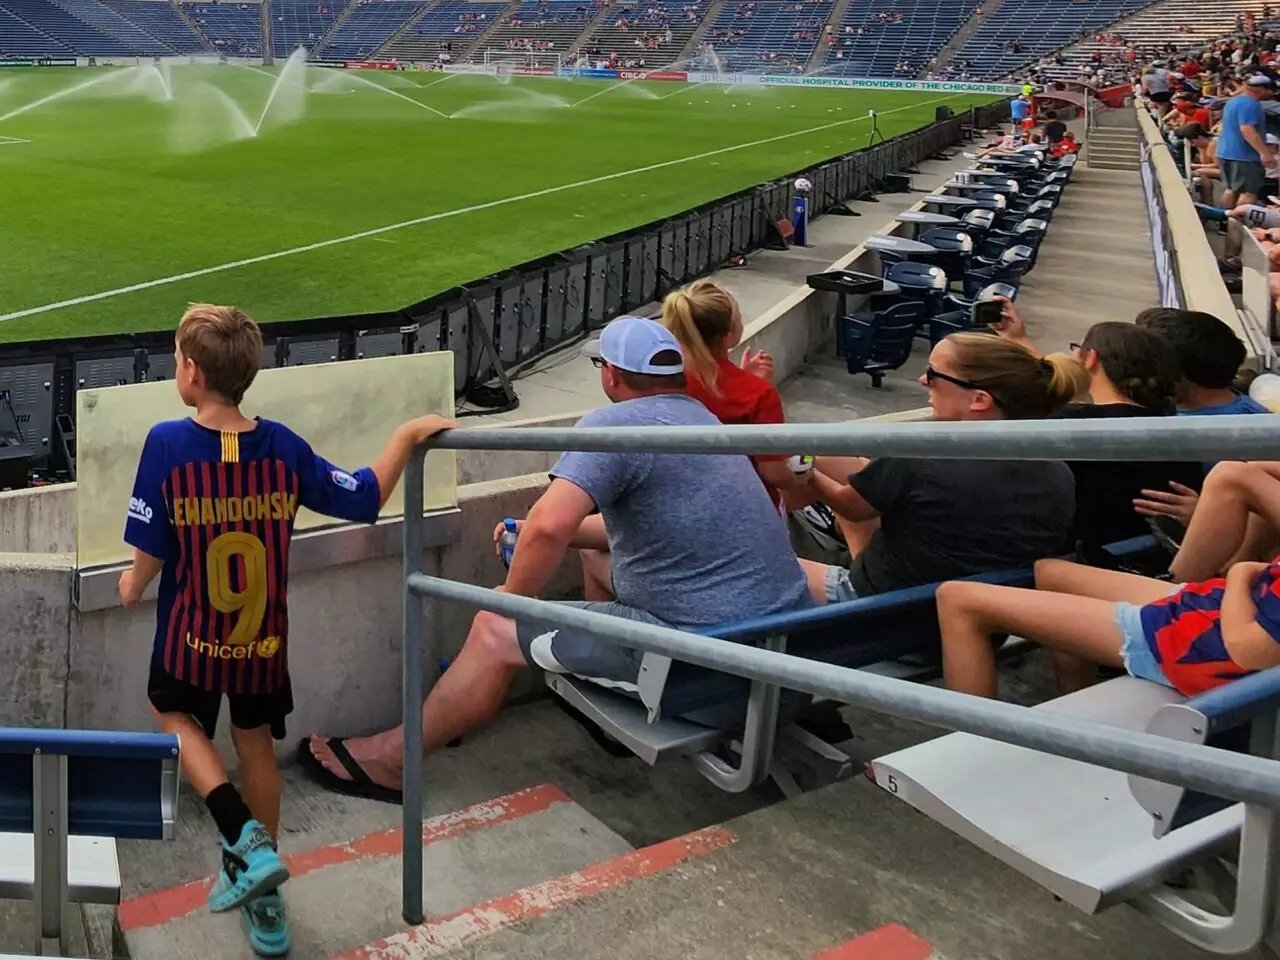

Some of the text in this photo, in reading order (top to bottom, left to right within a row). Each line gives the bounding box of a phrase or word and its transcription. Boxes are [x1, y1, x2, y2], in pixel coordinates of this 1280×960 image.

[759, 76, 800, 84] OFFICIAL
[802, 77, 849, 86] HOSPITAL
[852, 79, 902, 88] PROVIDER
[905, 81, 918, 89] OF
[942, 82, 985, 91] CHICAGO
[128, 496, 153, 518] eko
[168, 492, 298, 527] EWANDOWSK
[206, 531, 267, 646] 9
[186, 632, 257, 659] unicef
[888, 774, 898, 793] 5
